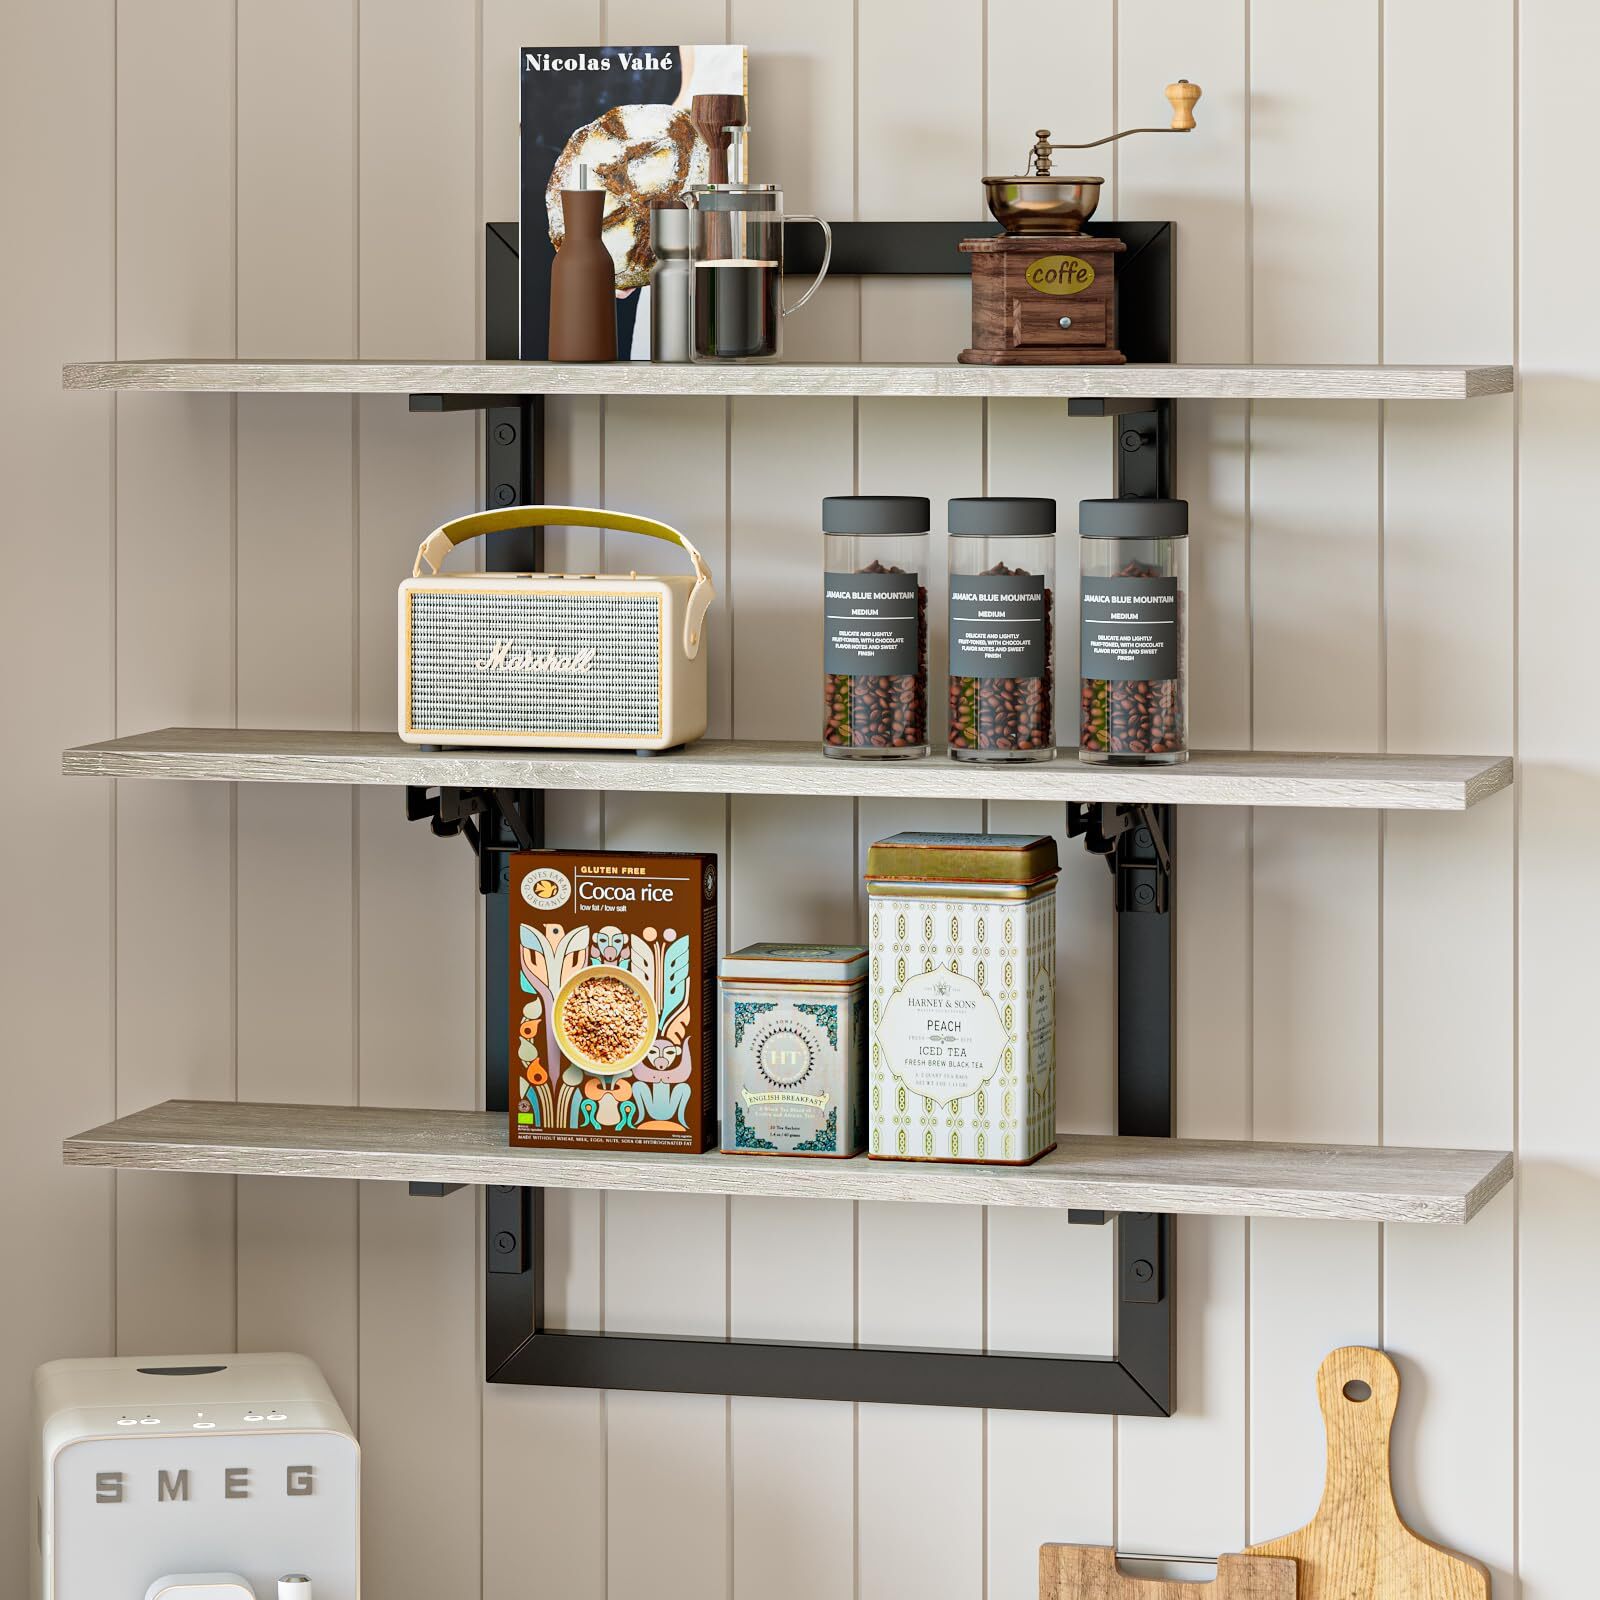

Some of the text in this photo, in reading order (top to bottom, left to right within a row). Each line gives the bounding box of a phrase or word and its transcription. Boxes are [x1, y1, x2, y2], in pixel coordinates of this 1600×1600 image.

[525, 52, 673, 72] Nicolas Vahé
[1032, 260, 1088, 285] coffe
[852, 592, 872, 600] BLUE
[873, 592, 914, 600] MOUNTAIN
[978, 593, 999, 601] BLUE
[1000, 594, 1041, 602] MOUNTAIN
[1111, 596, 1131, 604] BLUE
[1133, 596, 1174, 604] MOUNTAIN
[851, 608, 879, 616] MEDIUM
[978, 610, 1005, 618] MEDIUM
[475, 638, 597, 673] Marshall
[580, 866, 646, 875] GLUTEN FREE
[524, 871, 568, 891] DOVES FARM
[578, 881, 674, 902] Cocoa rice
[526, 893, 567, 907] ORGANIC
[604, 904, 616, 912] low
[908, 998, 976, 1009] HARNEY & SONS
[927, 1020, 961, 1032] PEACH
[919, 1046, 967, 1057] ICED TEA
[904, 1058, 926, 1066] FRESH
[948, 1060, 969, 1068] BLACK
[748, 1094, 824, 1106] ENGLISH BREAKFAST
[95, 1465, 313, 1503] SMEG
